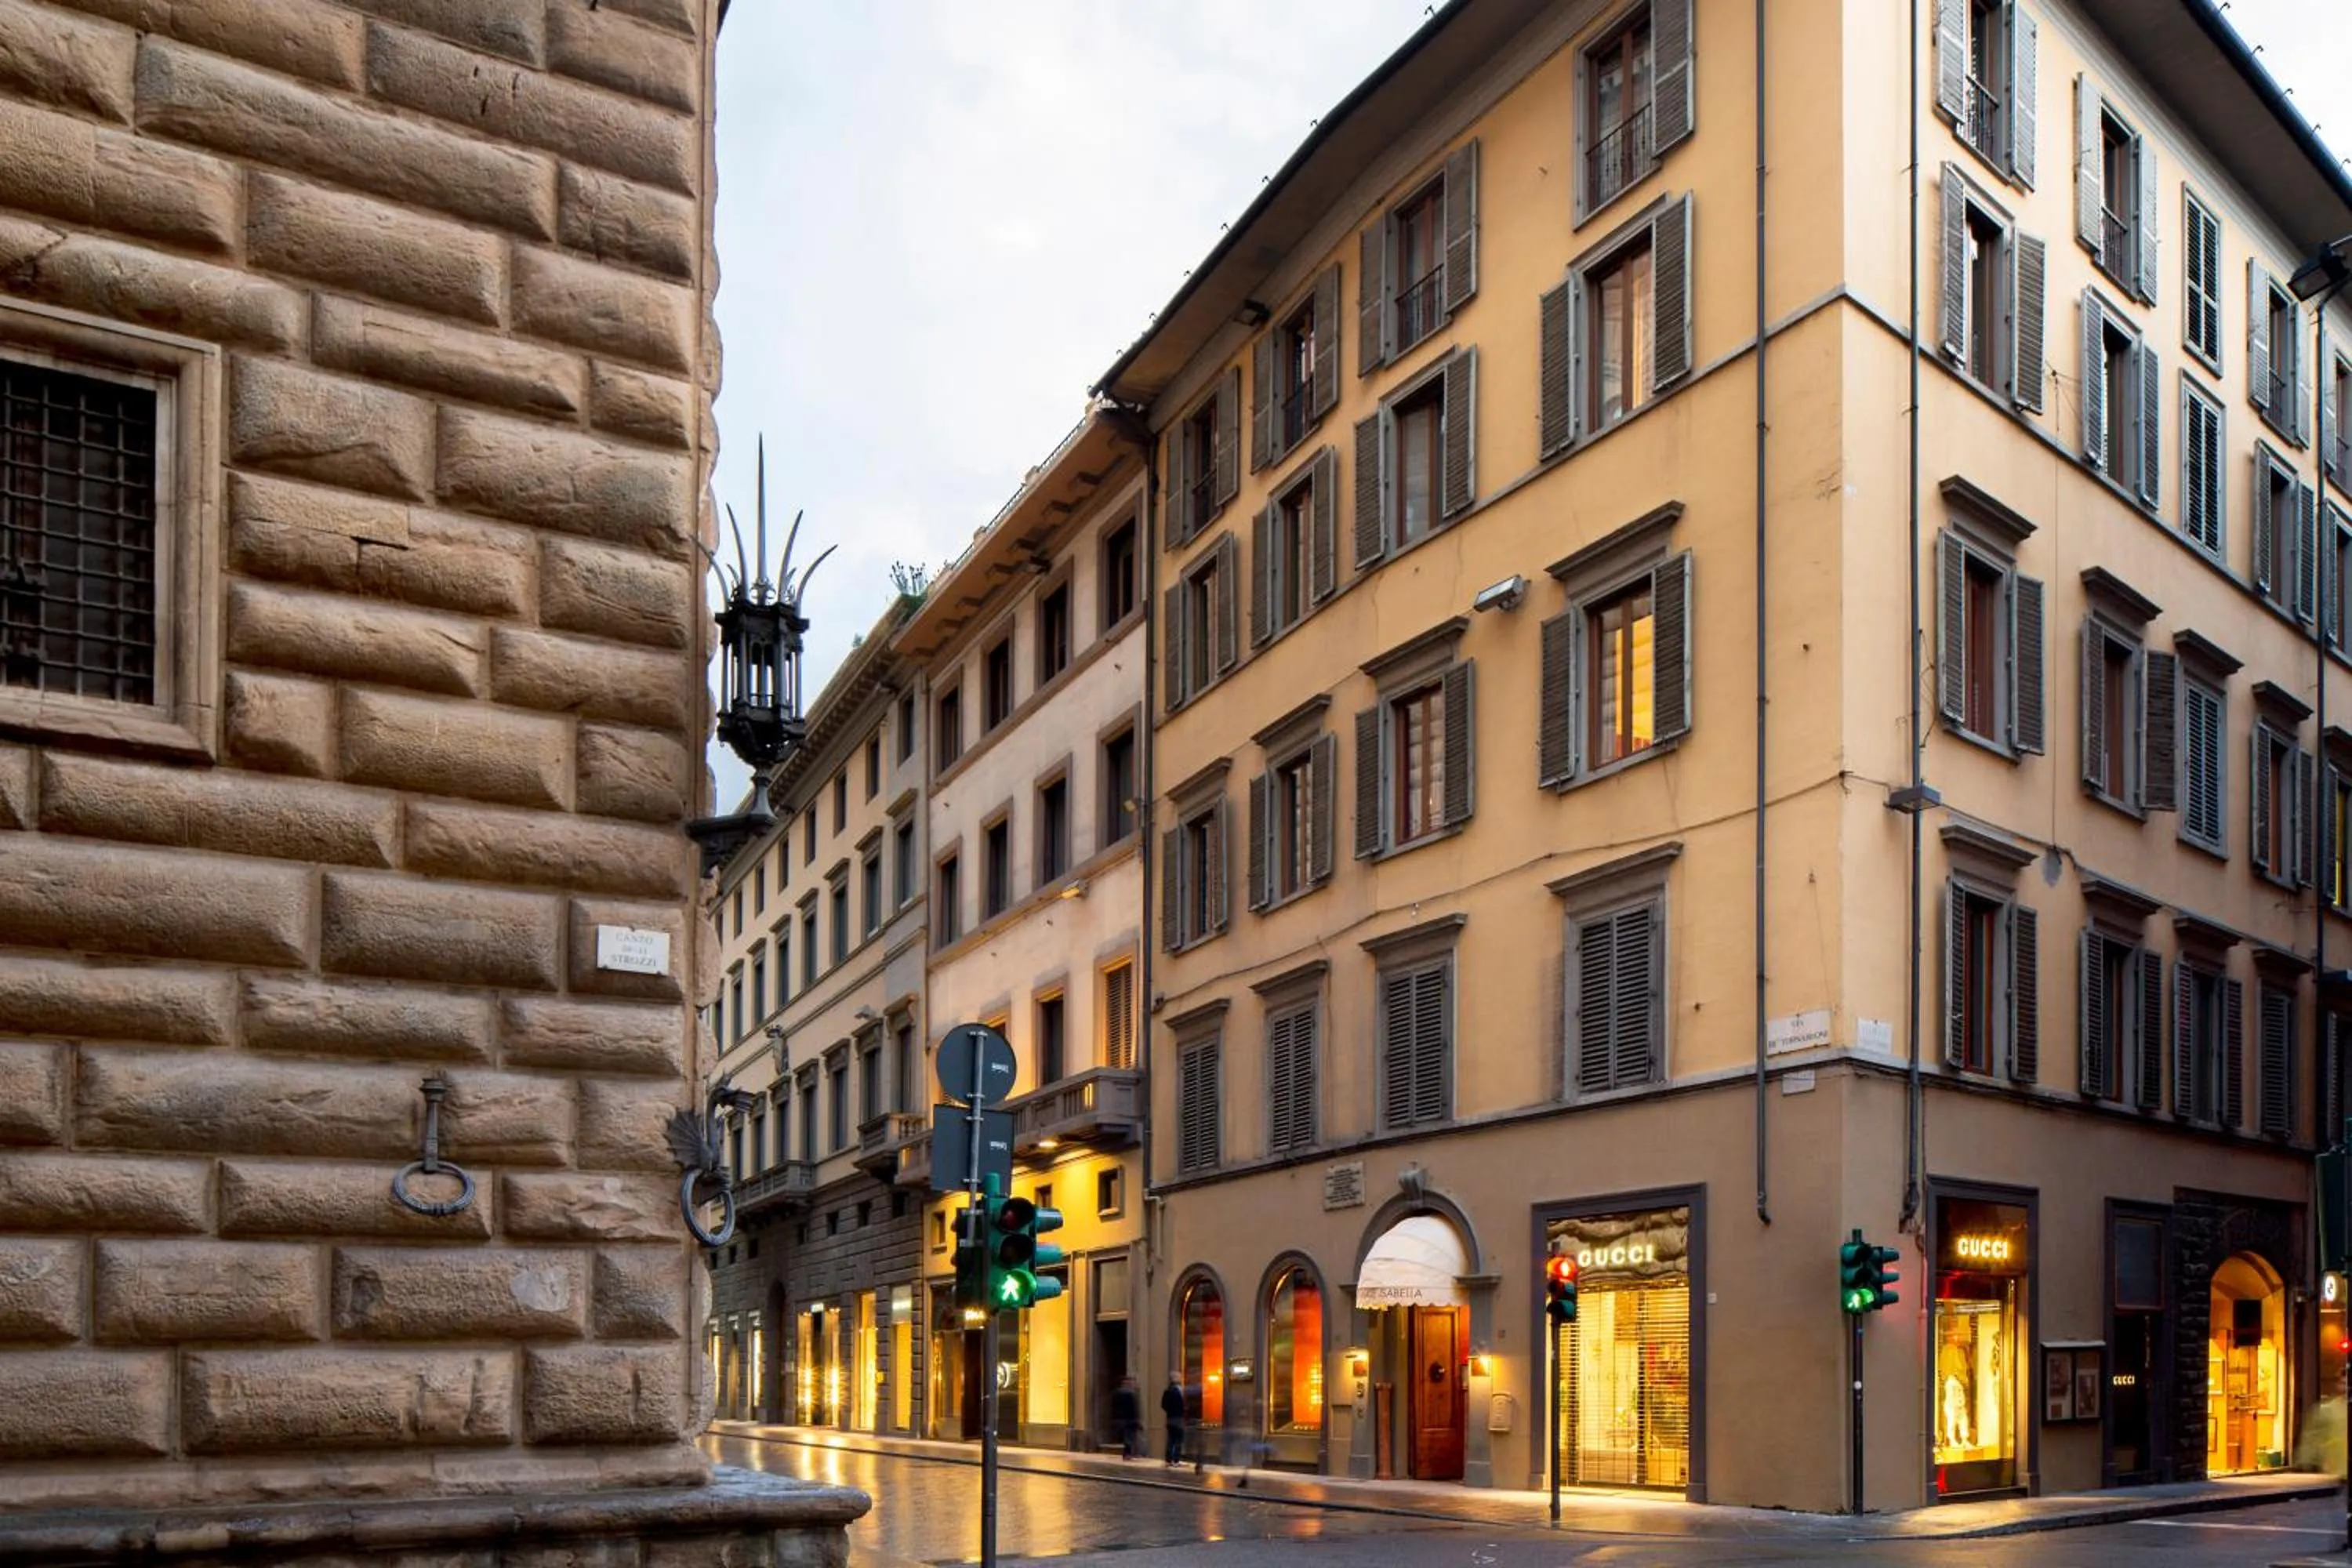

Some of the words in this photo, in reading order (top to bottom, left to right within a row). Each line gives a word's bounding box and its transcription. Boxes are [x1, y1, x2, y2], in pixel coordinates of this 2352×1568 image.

[611, 954, 656, 967] STROZZI
[1577, 1243, 1653, 1268] GUCCI
[1958, 1237, 2008, 1259] GUCCI
[2113, 1374, 2135, 1386] GUCCI
